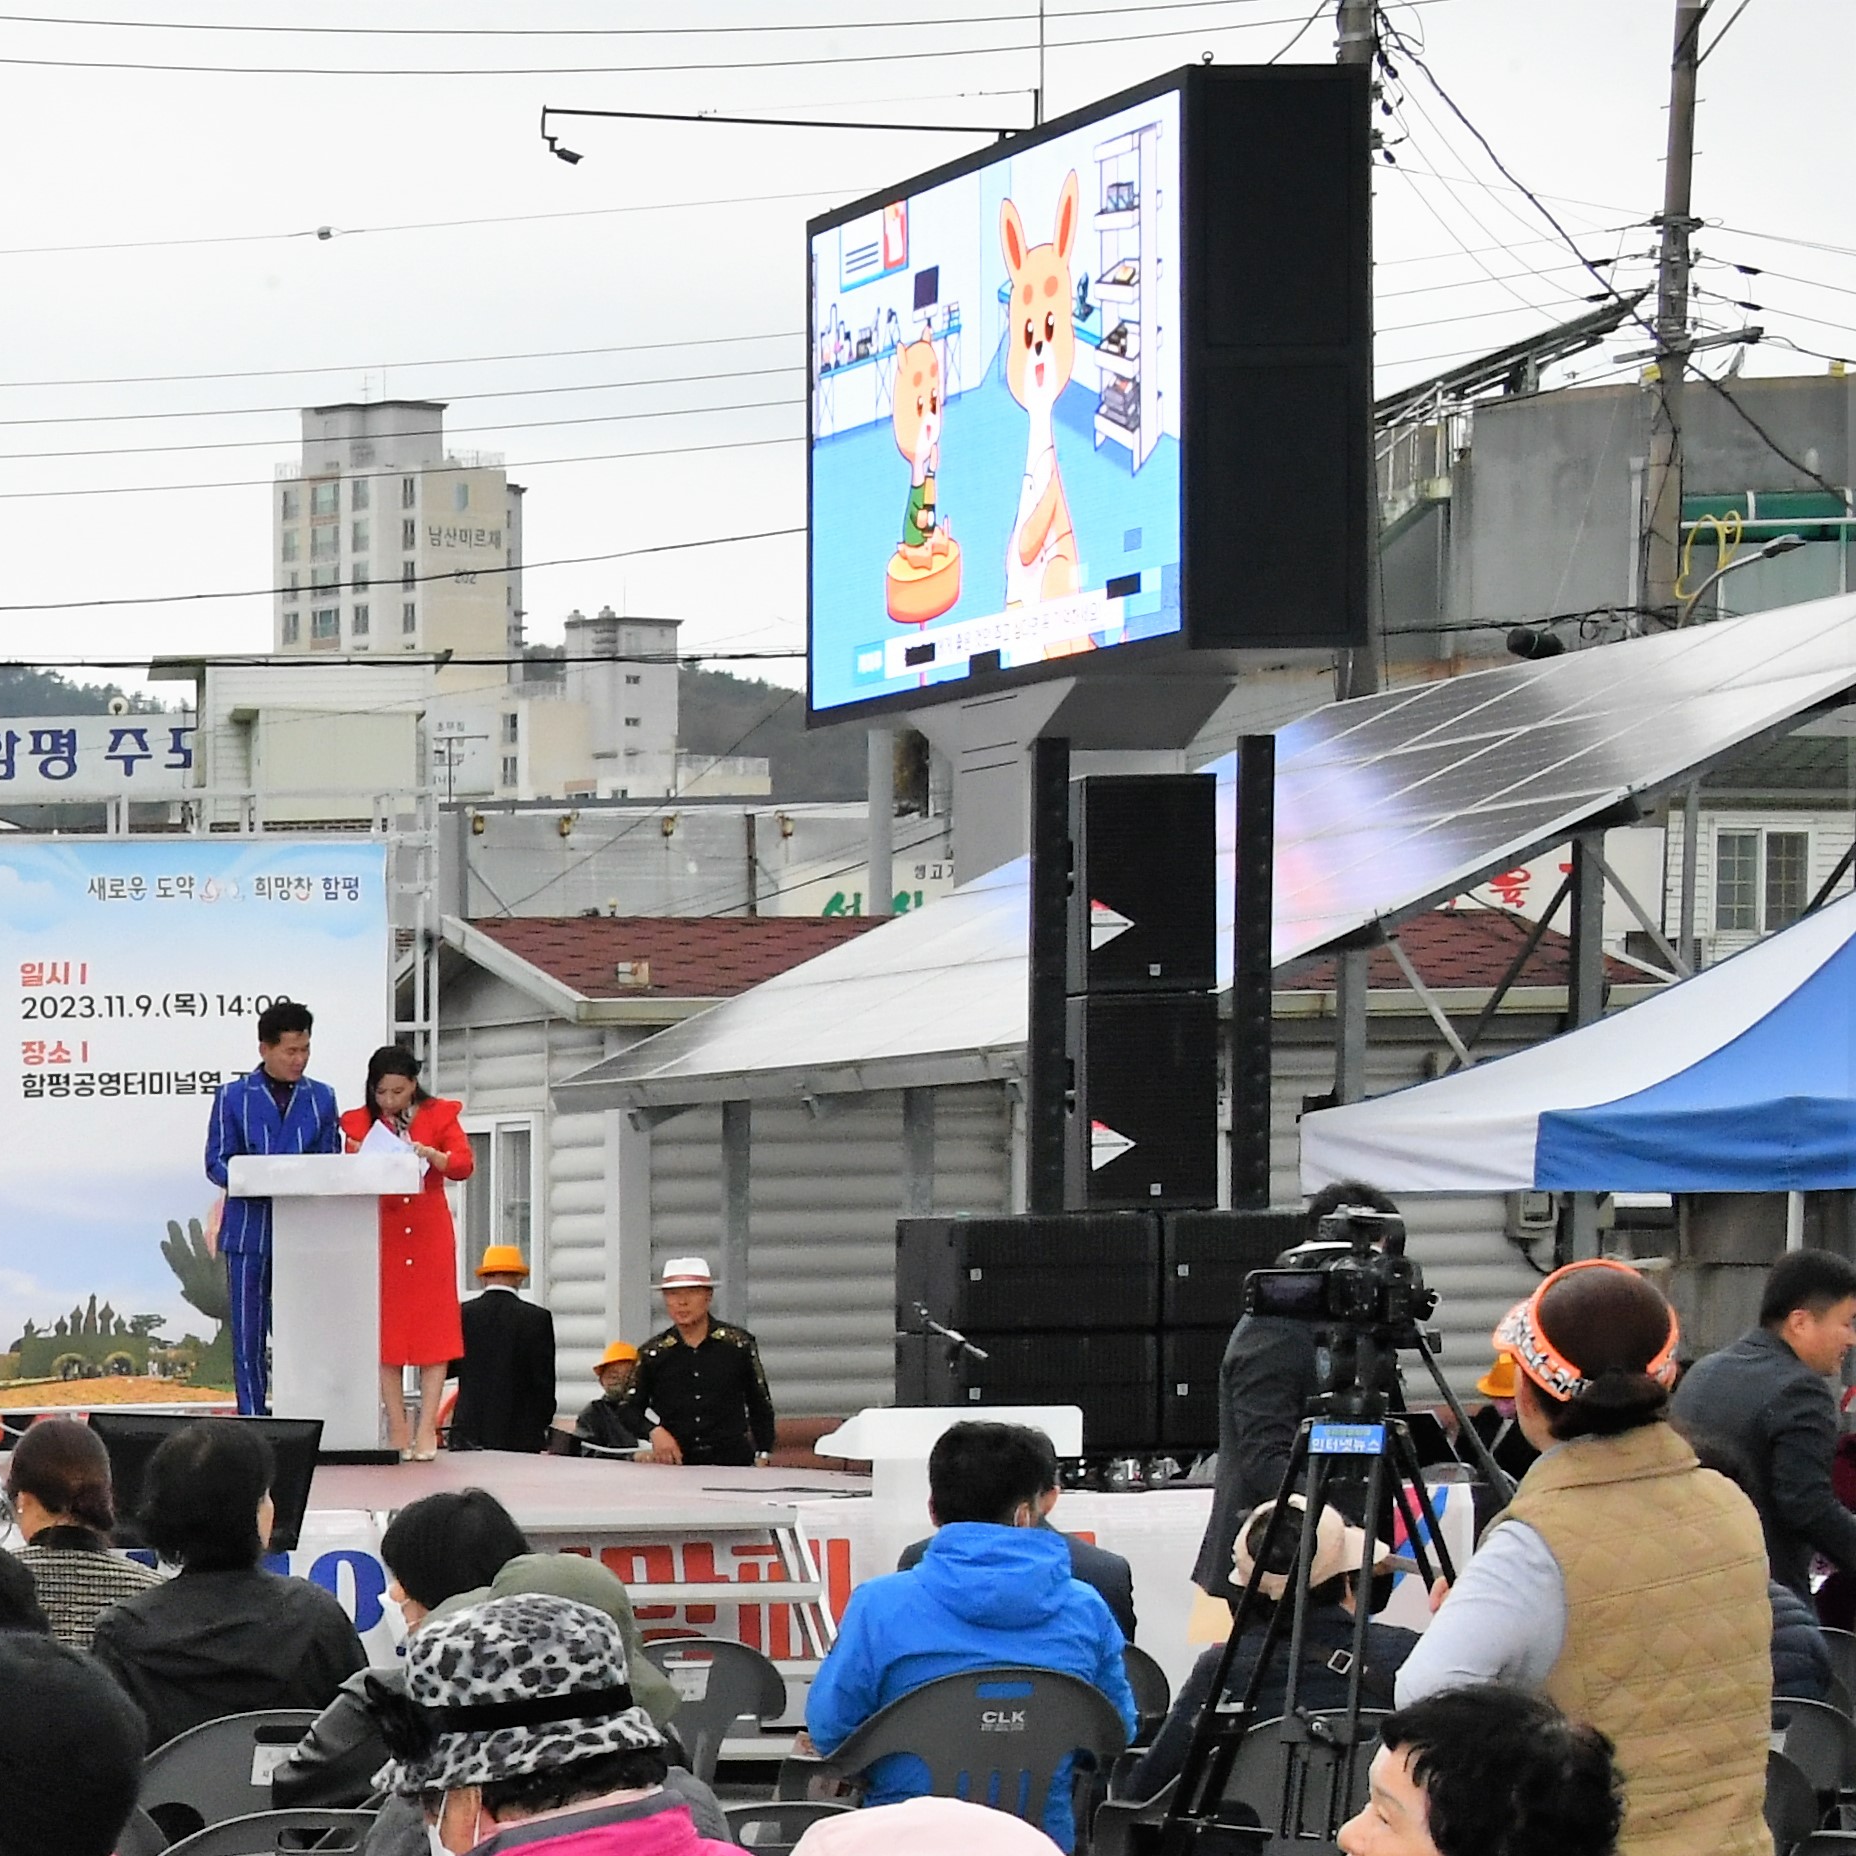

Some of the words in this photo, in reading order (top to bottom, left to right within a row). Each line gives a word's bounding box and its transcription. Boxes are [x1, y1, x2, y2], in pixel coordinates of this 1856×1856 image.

[88, 876, 148, 901] 새로운
[155, 876, 195, 900] 도약
[321, 876, 360, 901] 함평
[20, 961, 70, 987] 일시
[21, 992, 208, 1020] 2023.11.9.(목)
[21, 1040, 72, 1066] 장소
[21, 1071, 222, 1098] 함평공영터미널옆
[982, 1710, 1026, 1724] CLK
